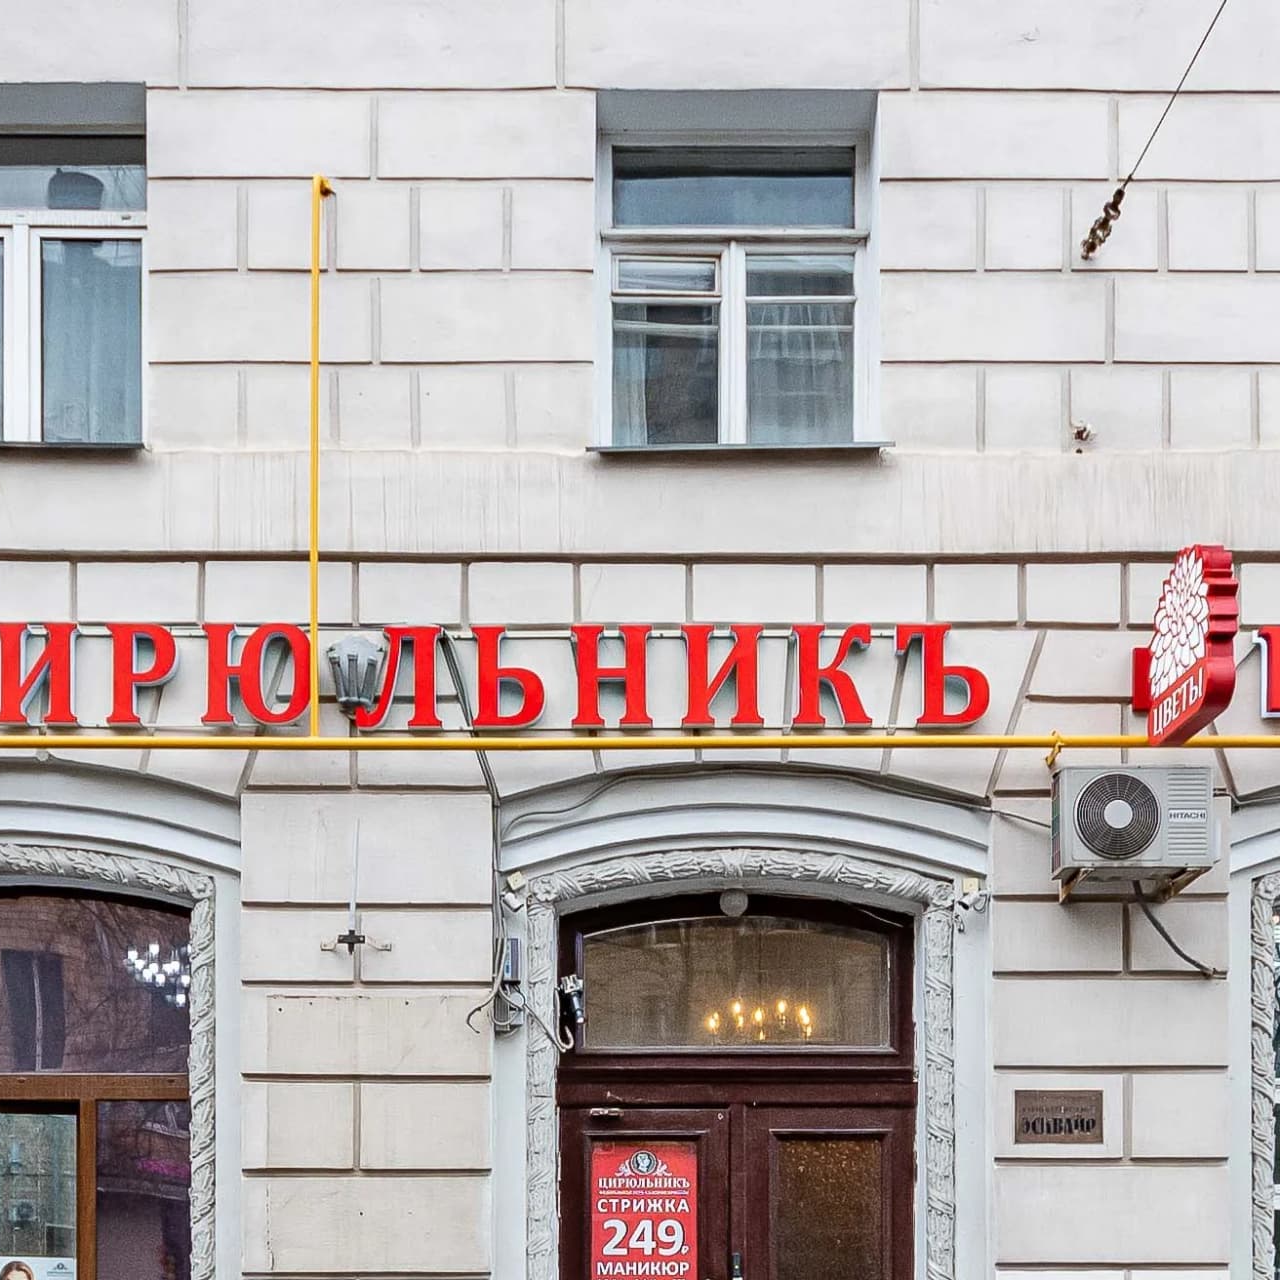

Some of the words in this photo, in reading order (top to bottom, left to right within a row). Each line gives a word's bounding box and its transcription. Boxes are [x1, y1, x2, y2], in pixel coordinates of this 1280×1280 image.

[1152, 667, 1204, 737] ЦВЕТЫ
[1168, 812, 1206, 820] HITACHI
[598, 1176, 690, 1190] ЦИРЮЛЬНИКЪ
[597, 1198, 690, 1213] СТРИЖКА
[597, 1261, 690, 1276] МАНИКЮР
